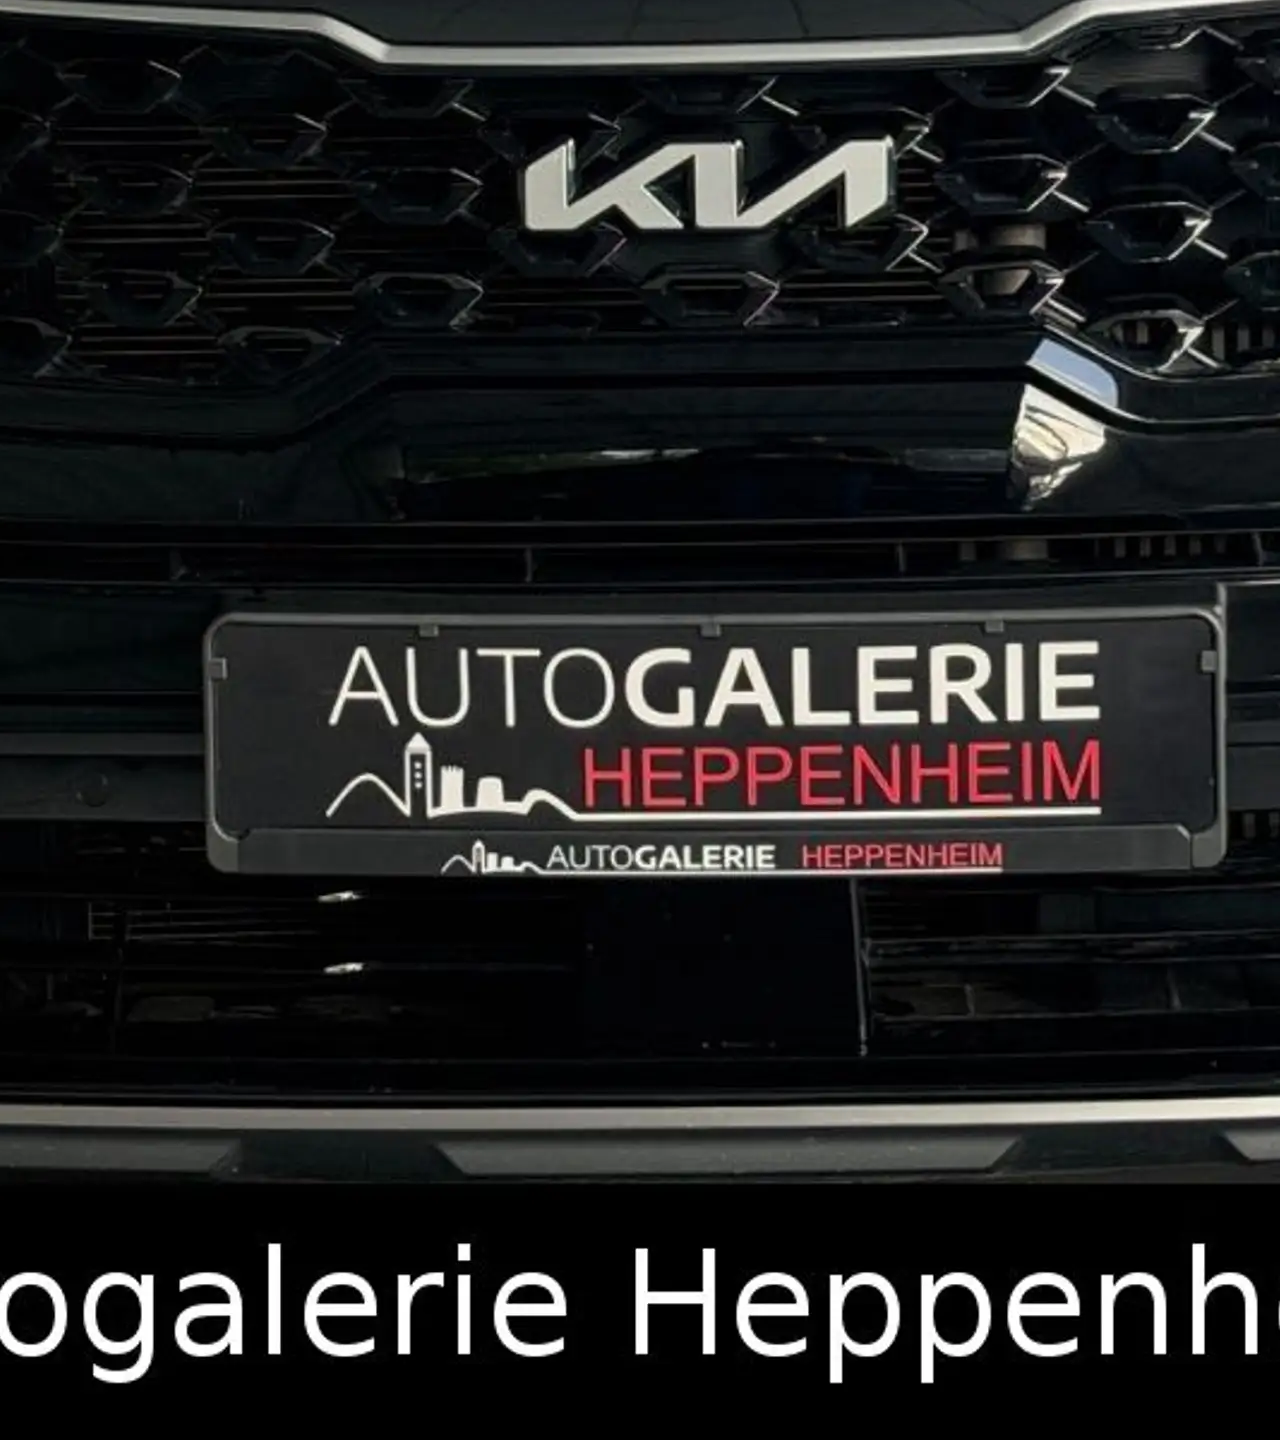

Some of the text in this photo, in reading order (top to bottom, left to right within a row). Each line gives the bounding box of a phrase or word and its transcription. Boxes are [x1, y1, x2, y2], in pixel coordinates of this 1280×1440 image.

[523, 132, 897, 231] KIA
[328, 639, 1102, 728] AUTOGALERIE
[583, 739, 1102, 808] HEPPENHEIM
[547, 842, 1004, 871] AUTOGALERIE HEPPENHEIM
